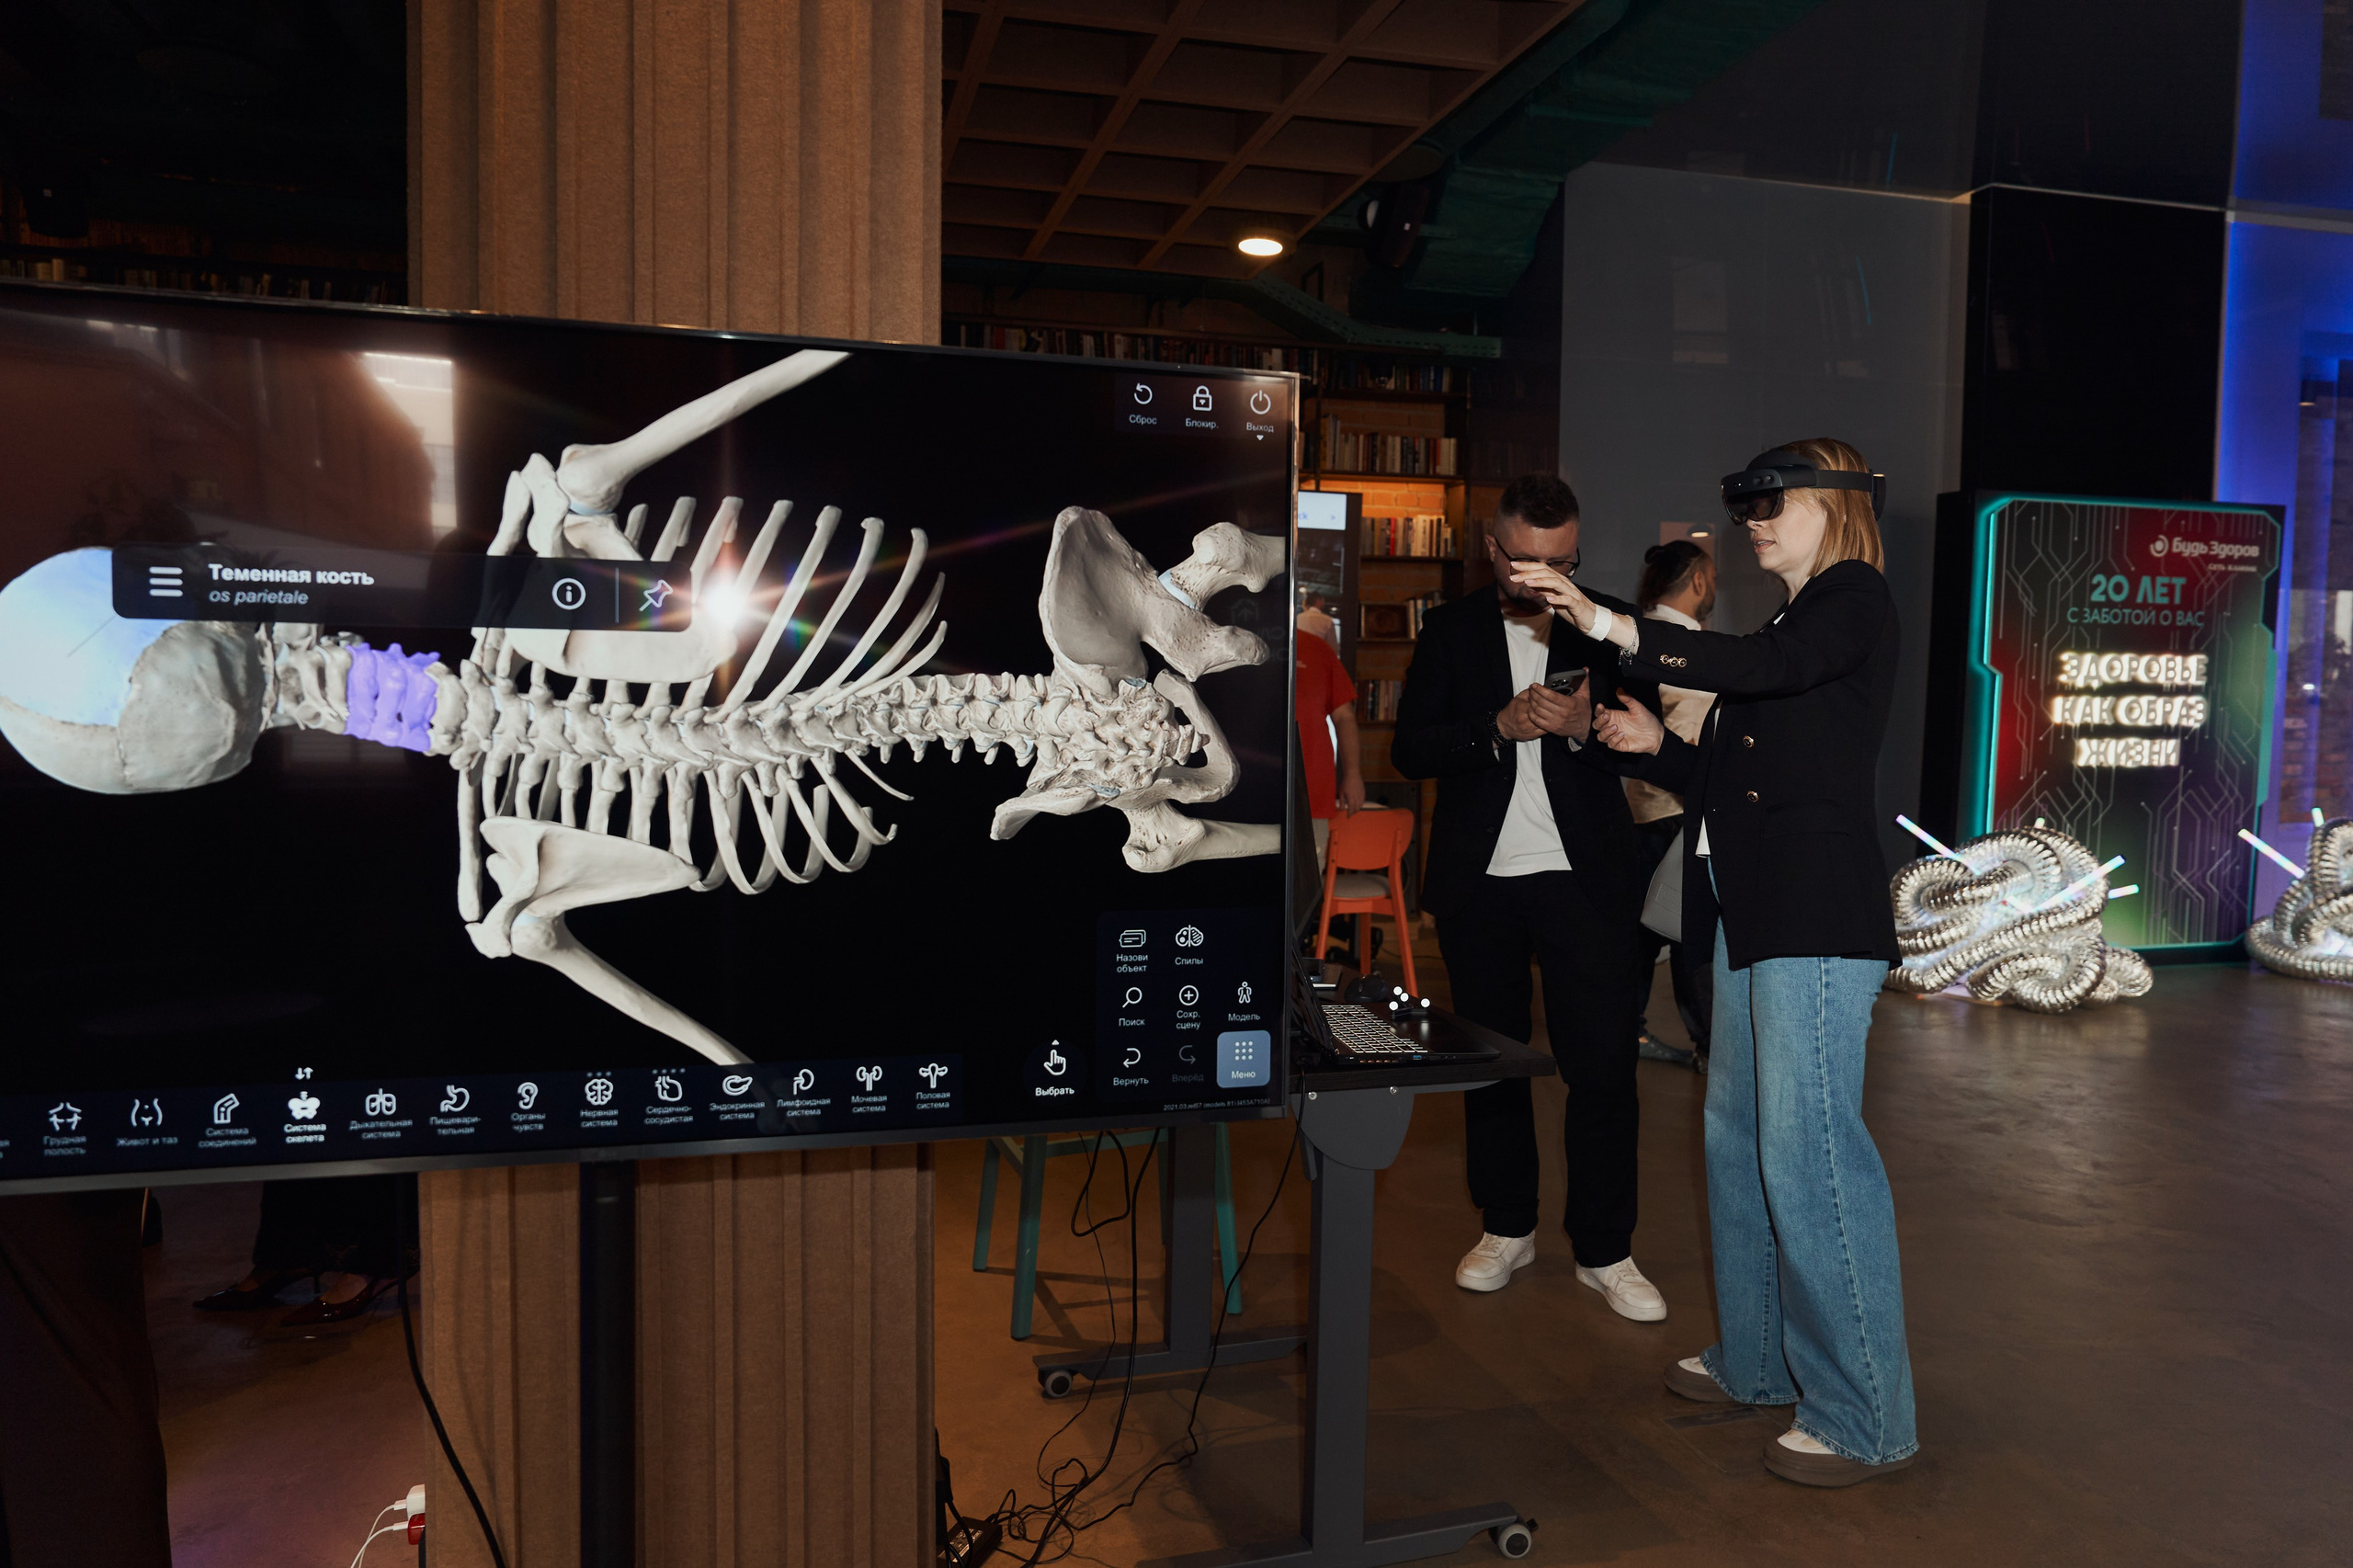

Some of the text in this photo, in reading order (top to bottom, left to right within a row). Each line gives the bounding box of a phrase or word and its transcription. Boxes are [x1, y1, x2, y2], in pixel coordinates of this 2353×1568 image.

[1129, 415, 1157, 426] Сброс
[1185, 418, 1219, 429] Блокир.
[1245, 422, 1274, 433] Выход
[2172, 537, 2260, 560] Будь Здоров
[208, 562, 375, 585] Теменная кость
[2090, 574, 2187, 605] 20 ЛЕТ
[209, 587, 309, 606] os parietale
[2067, 606, 2205, 627] С ЗАБОТОЙ О ВАС
[2059, 652, 2208, 686] ЗДОРОВЬЕ
[2052, 695, 2208, 726] КАК ОБРАЗ
[2075, 737, 2181, 767] ЖИЗНИ
[1116, 952, 1148, 962] Назови
[1175, 957, 1204, 966] Спилы
[1116, 964, 1147, 973] объект
[1176, 1010, 1201, 1020] Сохр.
[1228, 1013, 1261, 1022] Модель
[1119, 1017, 1145, 1027] Поиск
[1176, 1021, 1201, 1030] сцену
[1231, 1071, 1256, 1079] Меню
[1113, 1077, 1149, 1087] Вернуть
[915, 1091, 950, 1101] Половая
[1035, 1086, 1075, 1097] Выбрать
[777, 1096, 831, 1108] Лимфоидная
[851, 1095, 887, 1104] Мочевая
[645, 1105, 692, 1115] Сердечно-
[709, 1100, 766, 1112] Эндокринная
[852, 1105, 886, 1114] система
[916, 1101, 949, 1110] система
[510, 1112, 546, 1122] Органы
[580, 1108, 619, 1118] Нервная
[719, 1111, 755, 1121] система
[786, 1108, 821, 1118] система
[348, 1119, 413, 1131] Дыхательная
[581, 1119, 618, 1129] система
[644, 1115, 693, 1125] сосудистая
[205, 1127, 249, 1138] Система
[283, 1122, 326, 1133] Система
[438, 1126, 475, 1136] тельная
[513, 1123, 544, 1133] чувств
[285, 1133, 324, 1144] скелета
[361, 1130, 401, 1140] система
[43, 1135, 86, 1146] Грудная
[117, 1137, 150, 1147] Живот
[162, 1135, 178, 1145] таз
[44, 1147, 86, 1157] полость
